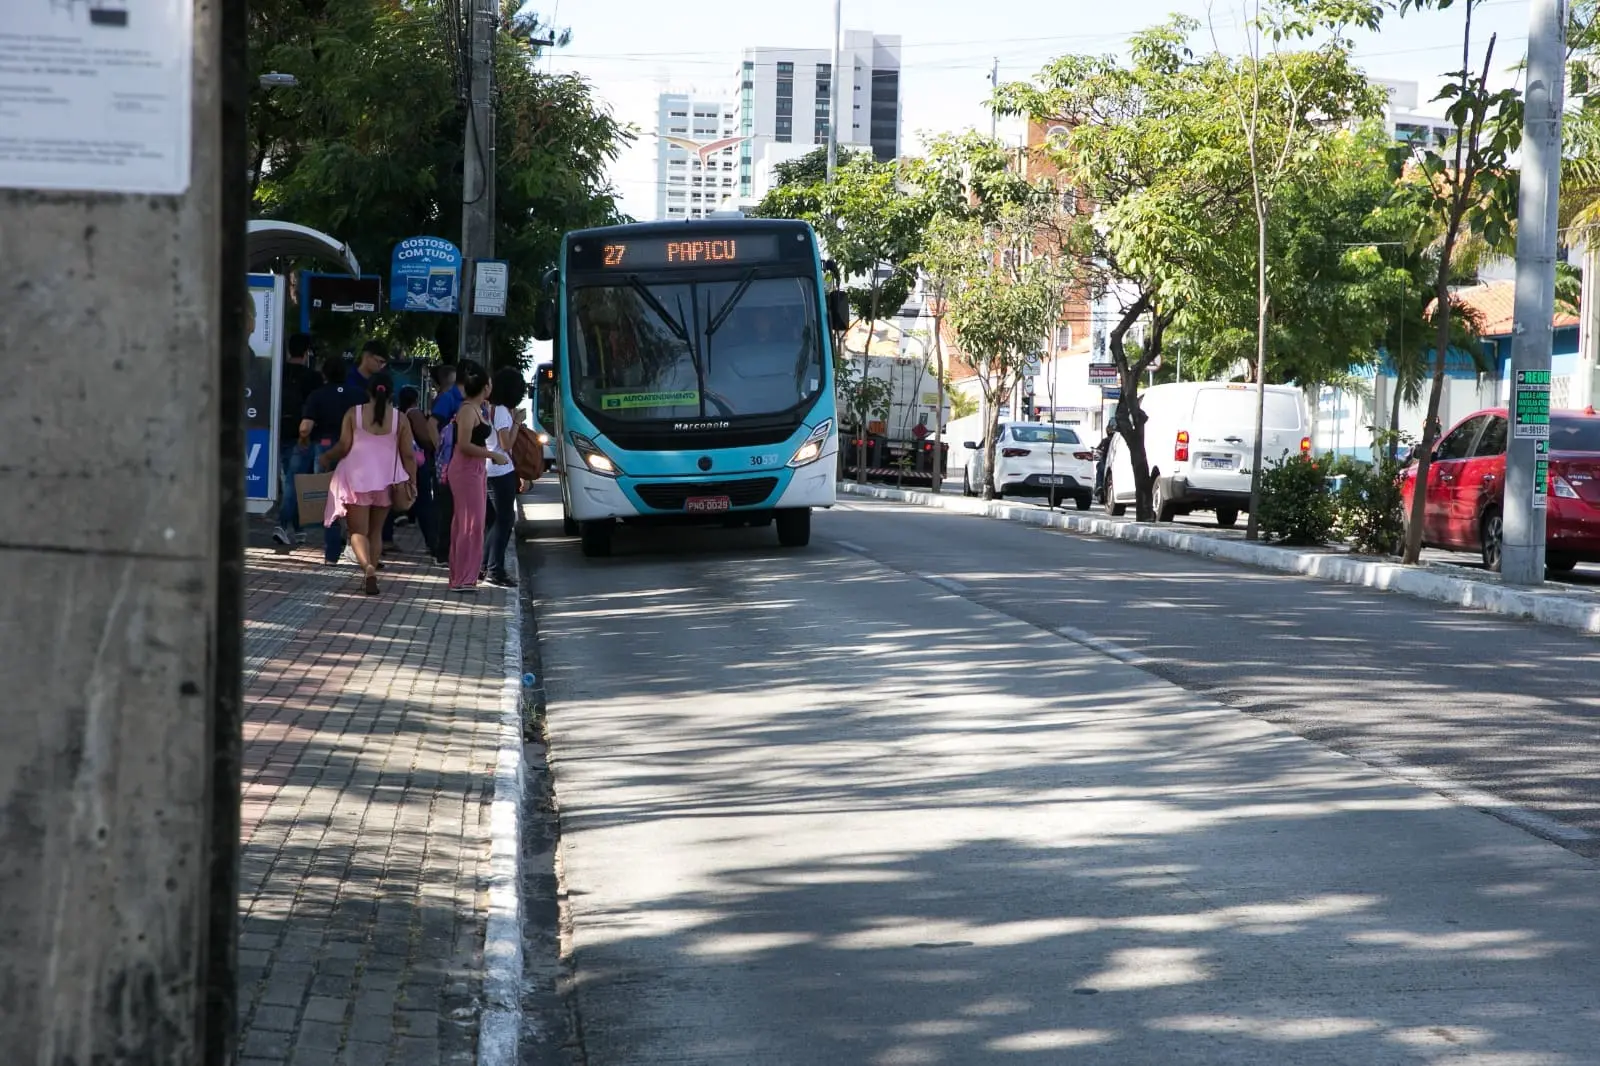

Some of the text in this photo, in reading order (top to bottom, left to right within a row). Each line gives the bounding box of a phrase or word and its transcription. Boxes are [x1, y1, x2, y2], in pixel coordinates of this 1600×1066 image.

[402, 239, 453, 252] GOSTOSO
[398, 248, 455, 263] COM TUDO
[604, 240, 736, 265] 27 PAPICU
[1525, 371, 1551, 383] REDU
[623, 392, 696, 402] AUTOATENDIMENTO
[674, 421, 729, 431] Marcopolo
